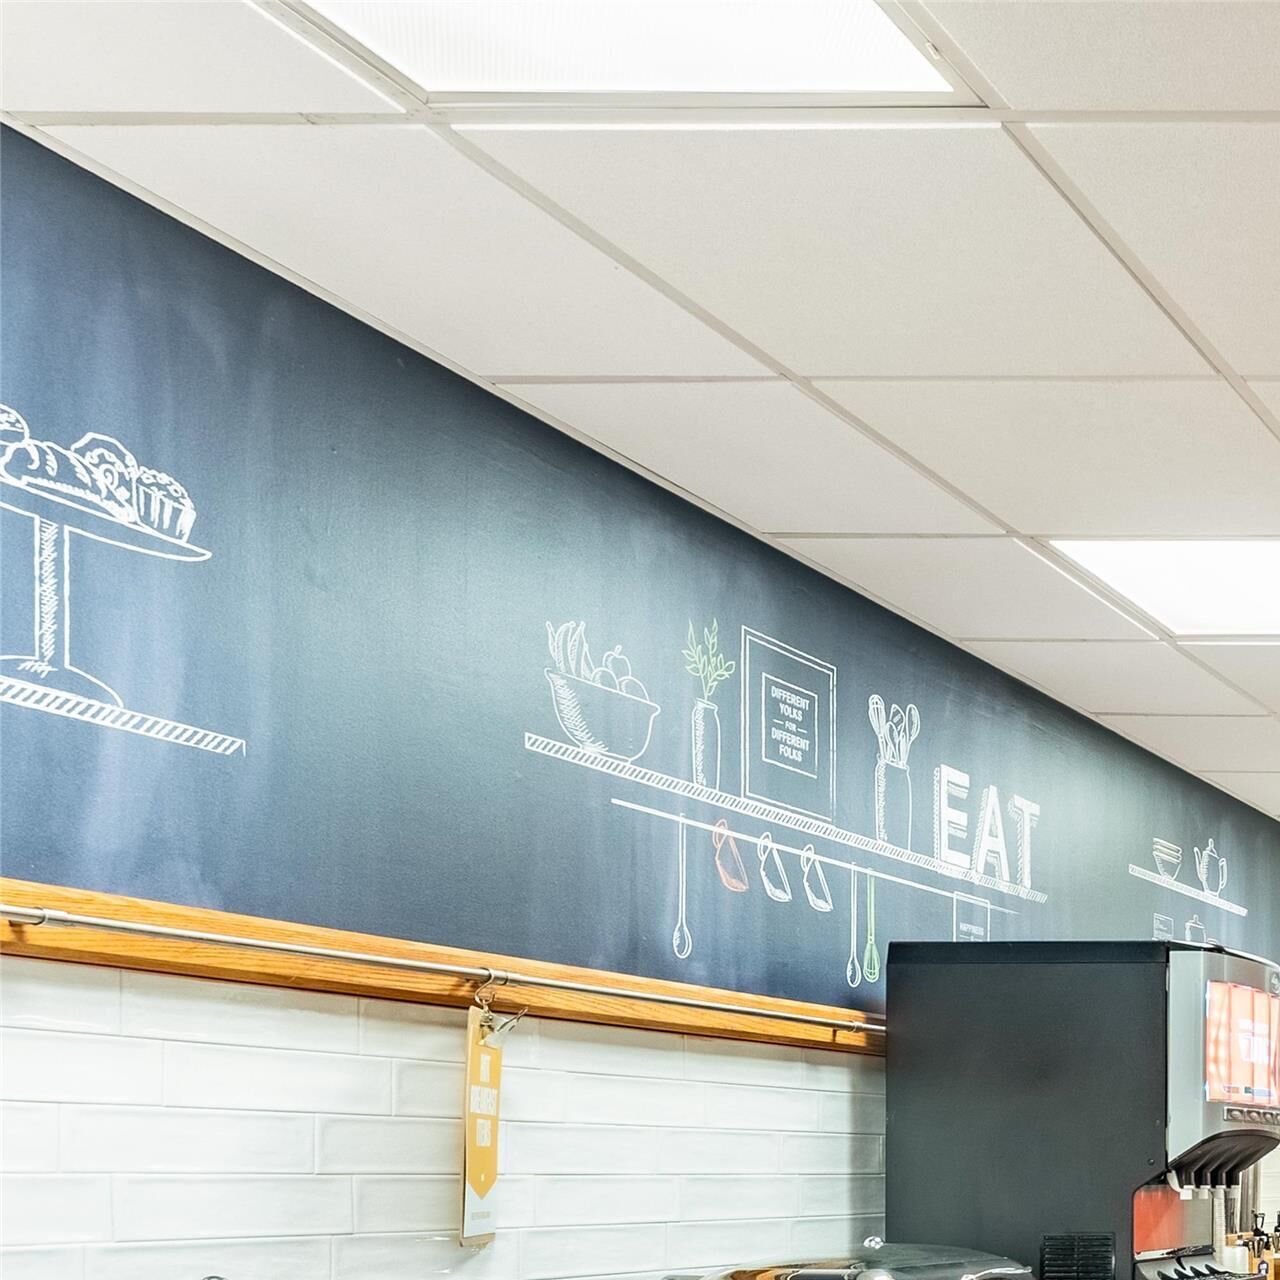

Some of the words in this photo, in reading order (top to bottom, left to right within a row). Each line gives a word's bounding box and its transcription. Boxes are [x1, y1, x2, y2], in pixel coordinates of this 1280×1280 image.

[771, 686, 810, 710] DIFFERENT
[779, 703, 803, 721] YOLKS
[785, 721, 797, 732] FOR
[771, 727, 810, 751] DIFFERENT
[779, 745, 803, 762] FOLKS
[934, 764, 1040, 889] EAT
